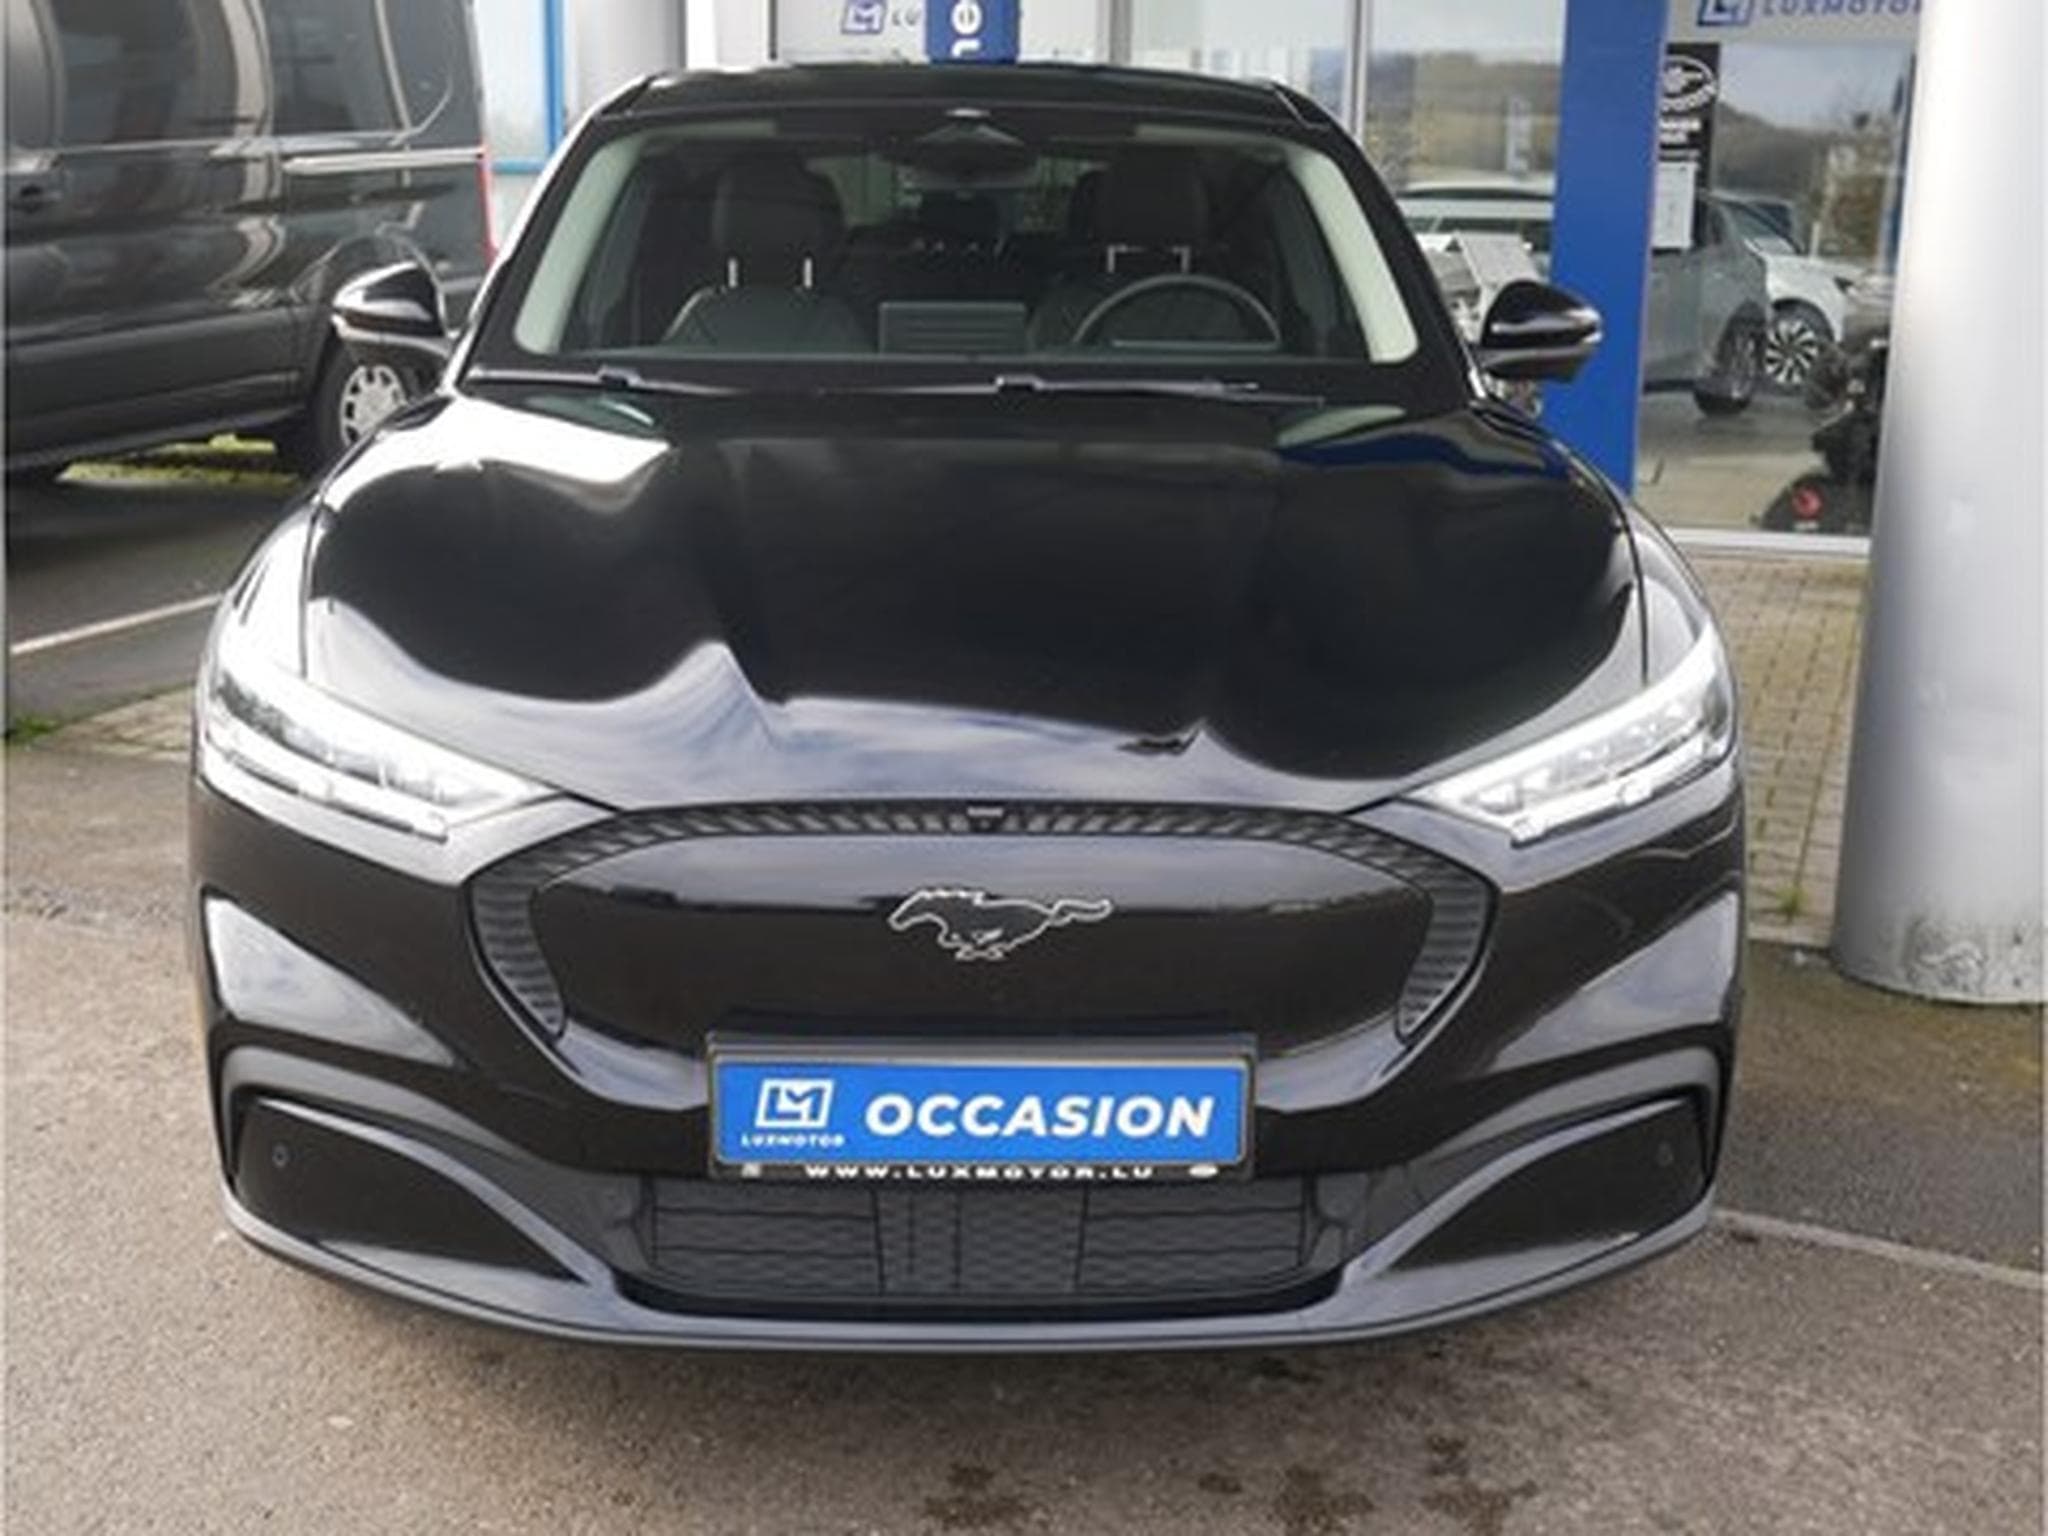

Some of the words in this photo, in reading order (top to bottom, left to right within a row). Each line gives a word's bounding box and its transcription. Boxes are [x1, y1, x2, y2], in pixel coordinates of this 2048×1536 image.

[865, 1093, 1214, 1138] OCCASION
[740, 1134, 846, 1147] LUXMOTOR
[805, 1164, 1153, 1178] WWW.LUXMOTOR.LU
